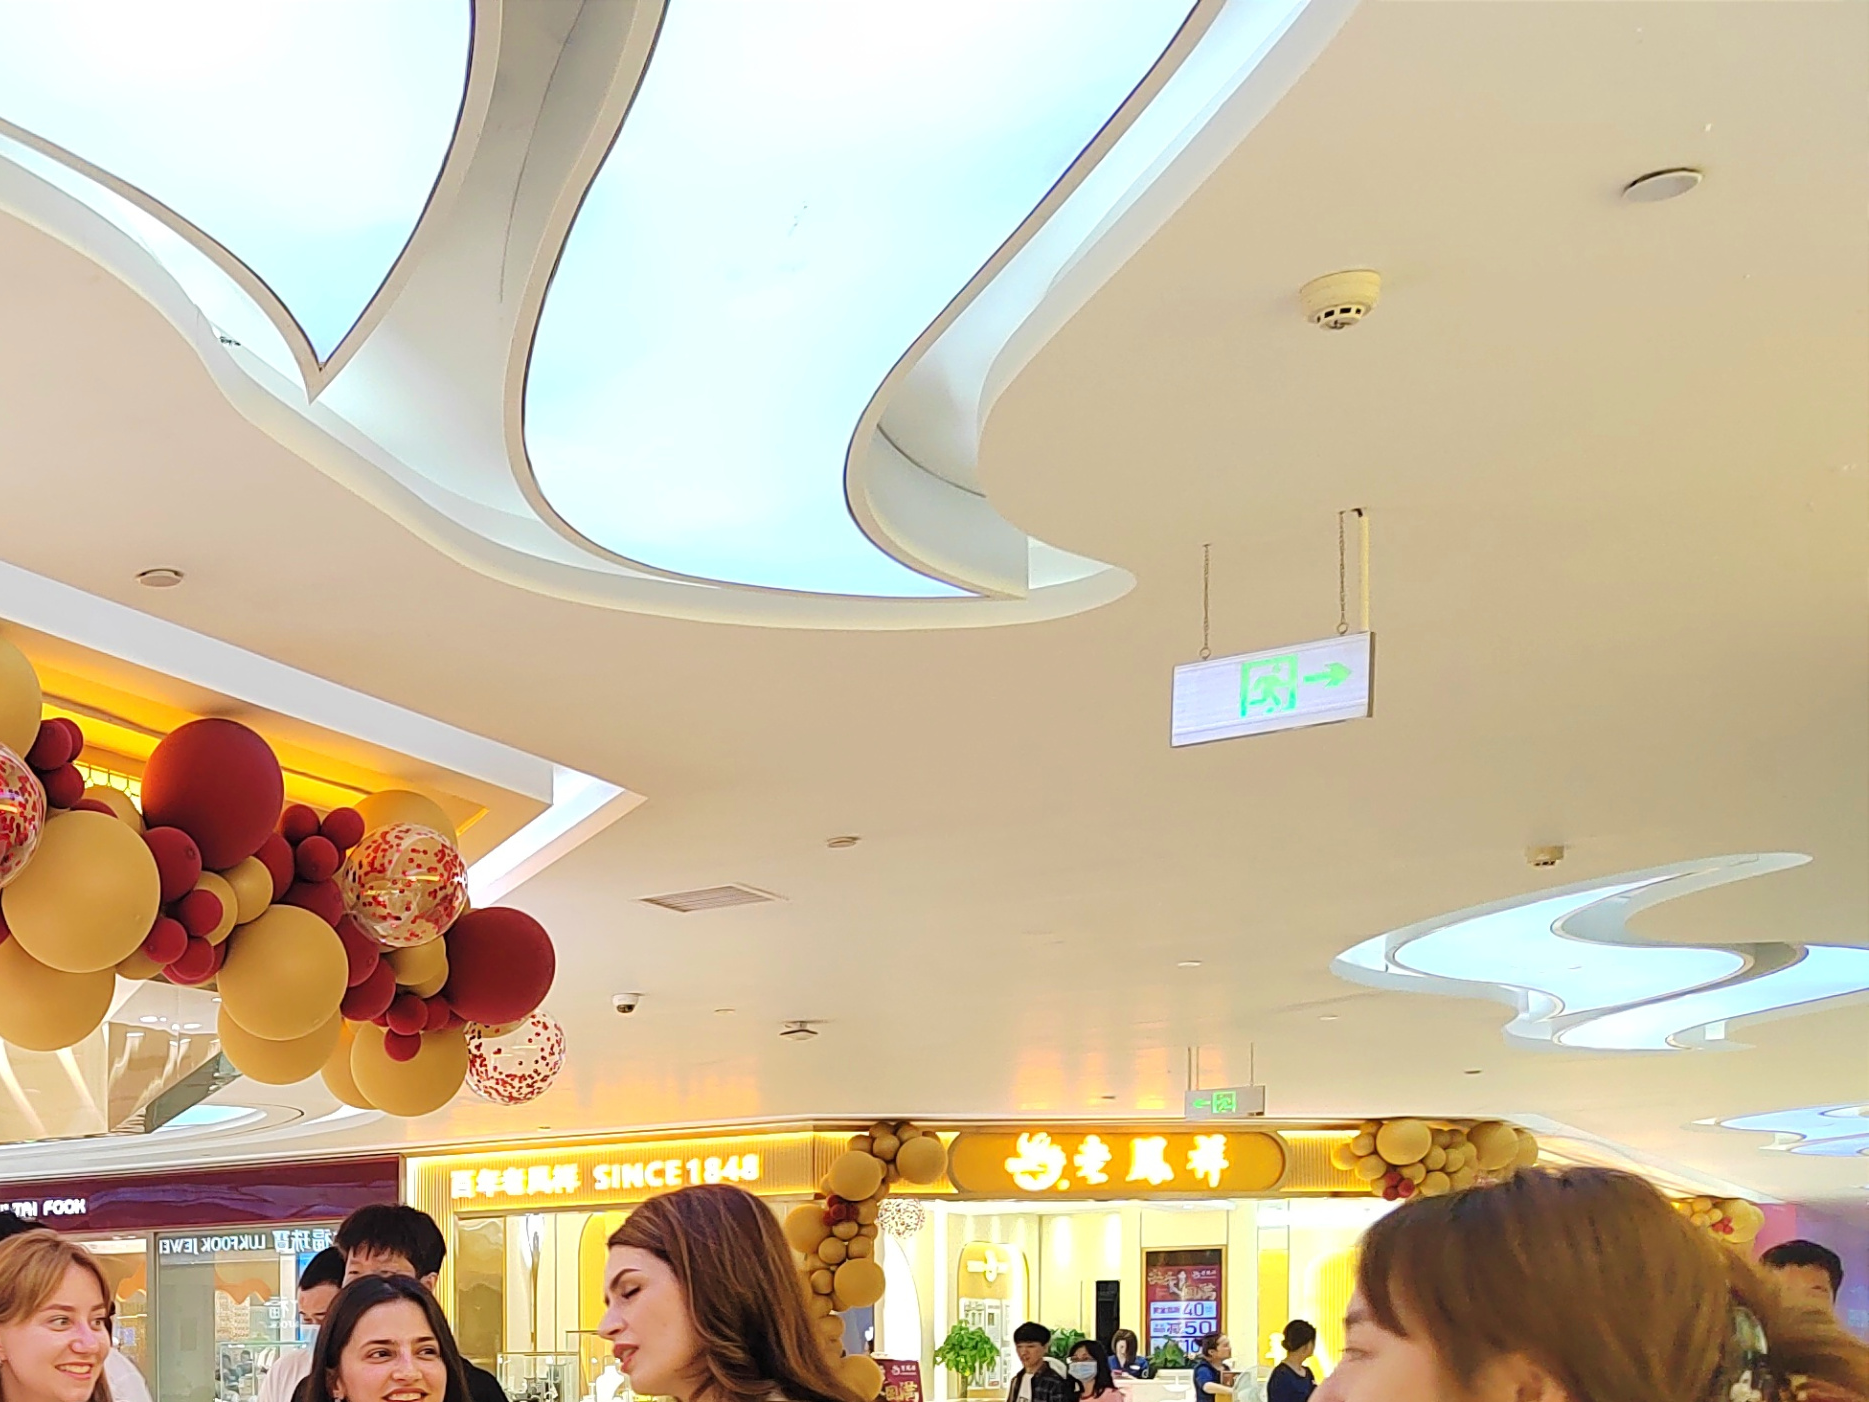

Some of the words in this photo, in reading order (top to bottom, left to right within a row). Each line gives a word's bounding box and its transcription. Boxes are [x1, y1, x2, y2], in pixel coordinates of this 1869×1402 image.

[593, 1159, 683, 1190] SINCE
[686, 1153, 760, 1185] 1848
[42, 1199, 87, 1216] FOOK
